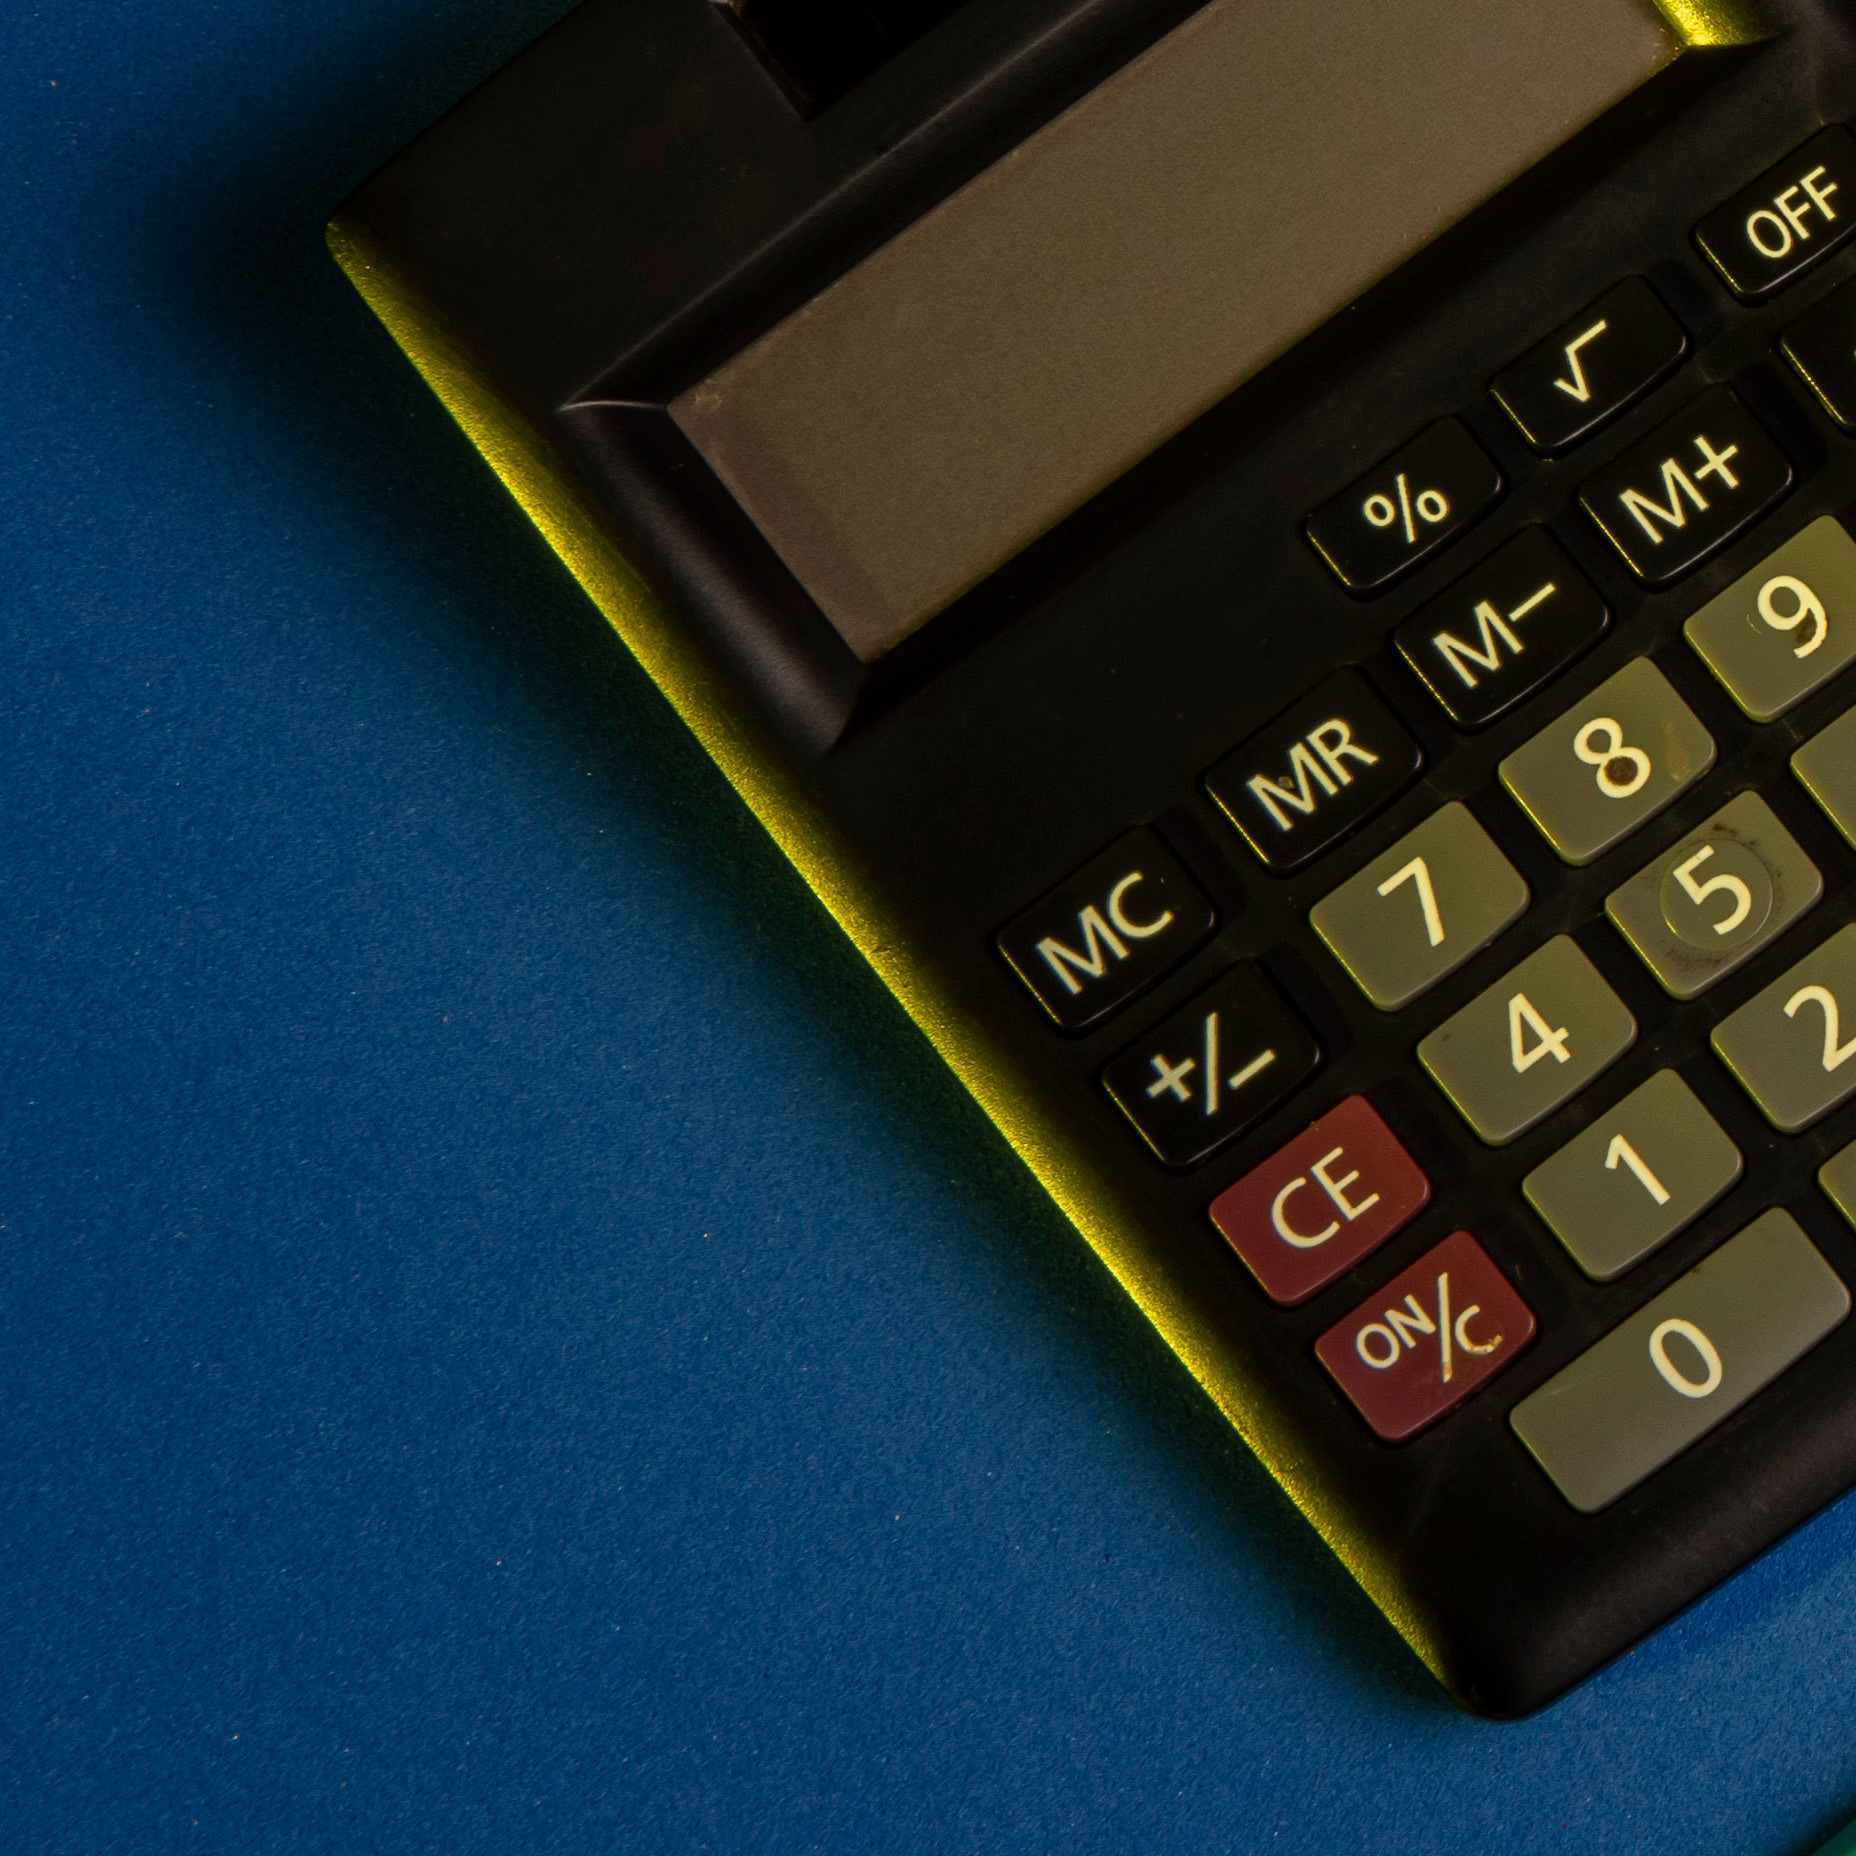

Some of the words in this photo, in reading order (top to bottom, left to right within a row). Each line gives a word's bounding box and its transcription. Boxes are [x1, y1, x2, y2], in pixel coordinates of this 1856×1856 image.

[1746, 165, 1838, 259] OFF
[1363, 473, 1449, 544] %
[1619, 435, 1739, 544] M+
[1757, 575, 1828, 659] 9
[1246, 718, 1379, 831] MR
[1573, 717, 1651, 799] 8
[1036, 872, 1174, 996] MC
[1377, 856, 1444, 947] 7
[1672, 845, 1752, 935] 5
[1508, 993, 1571, 1073] 4
[1271, 1146, 1380, 1248] CE
[1605, 1134, 1671, 1205] 1
[1356, 1271, 1503, 1383] ON/C
[1649, 1318, 1722, 1398] 0
